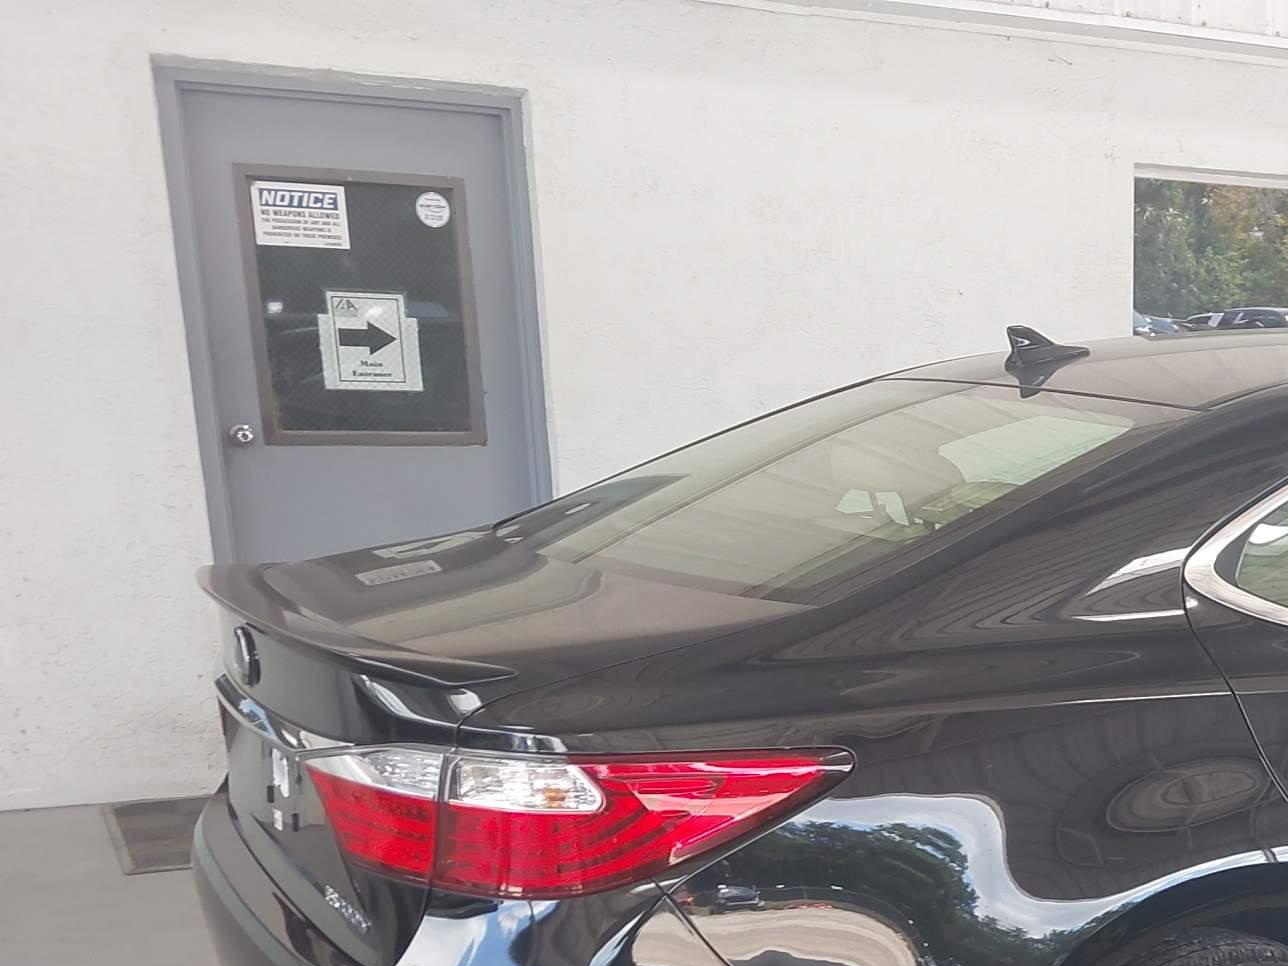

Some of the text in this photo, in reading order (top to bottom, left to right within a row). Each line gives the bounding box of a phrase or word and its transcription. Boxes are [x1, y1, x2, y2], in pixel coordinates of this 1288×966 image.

[261, 190, 337, 209] NOTICE
[272, 209, 306, 218] WEAPONS
[308, 211, 340, 220] ALLOWED
